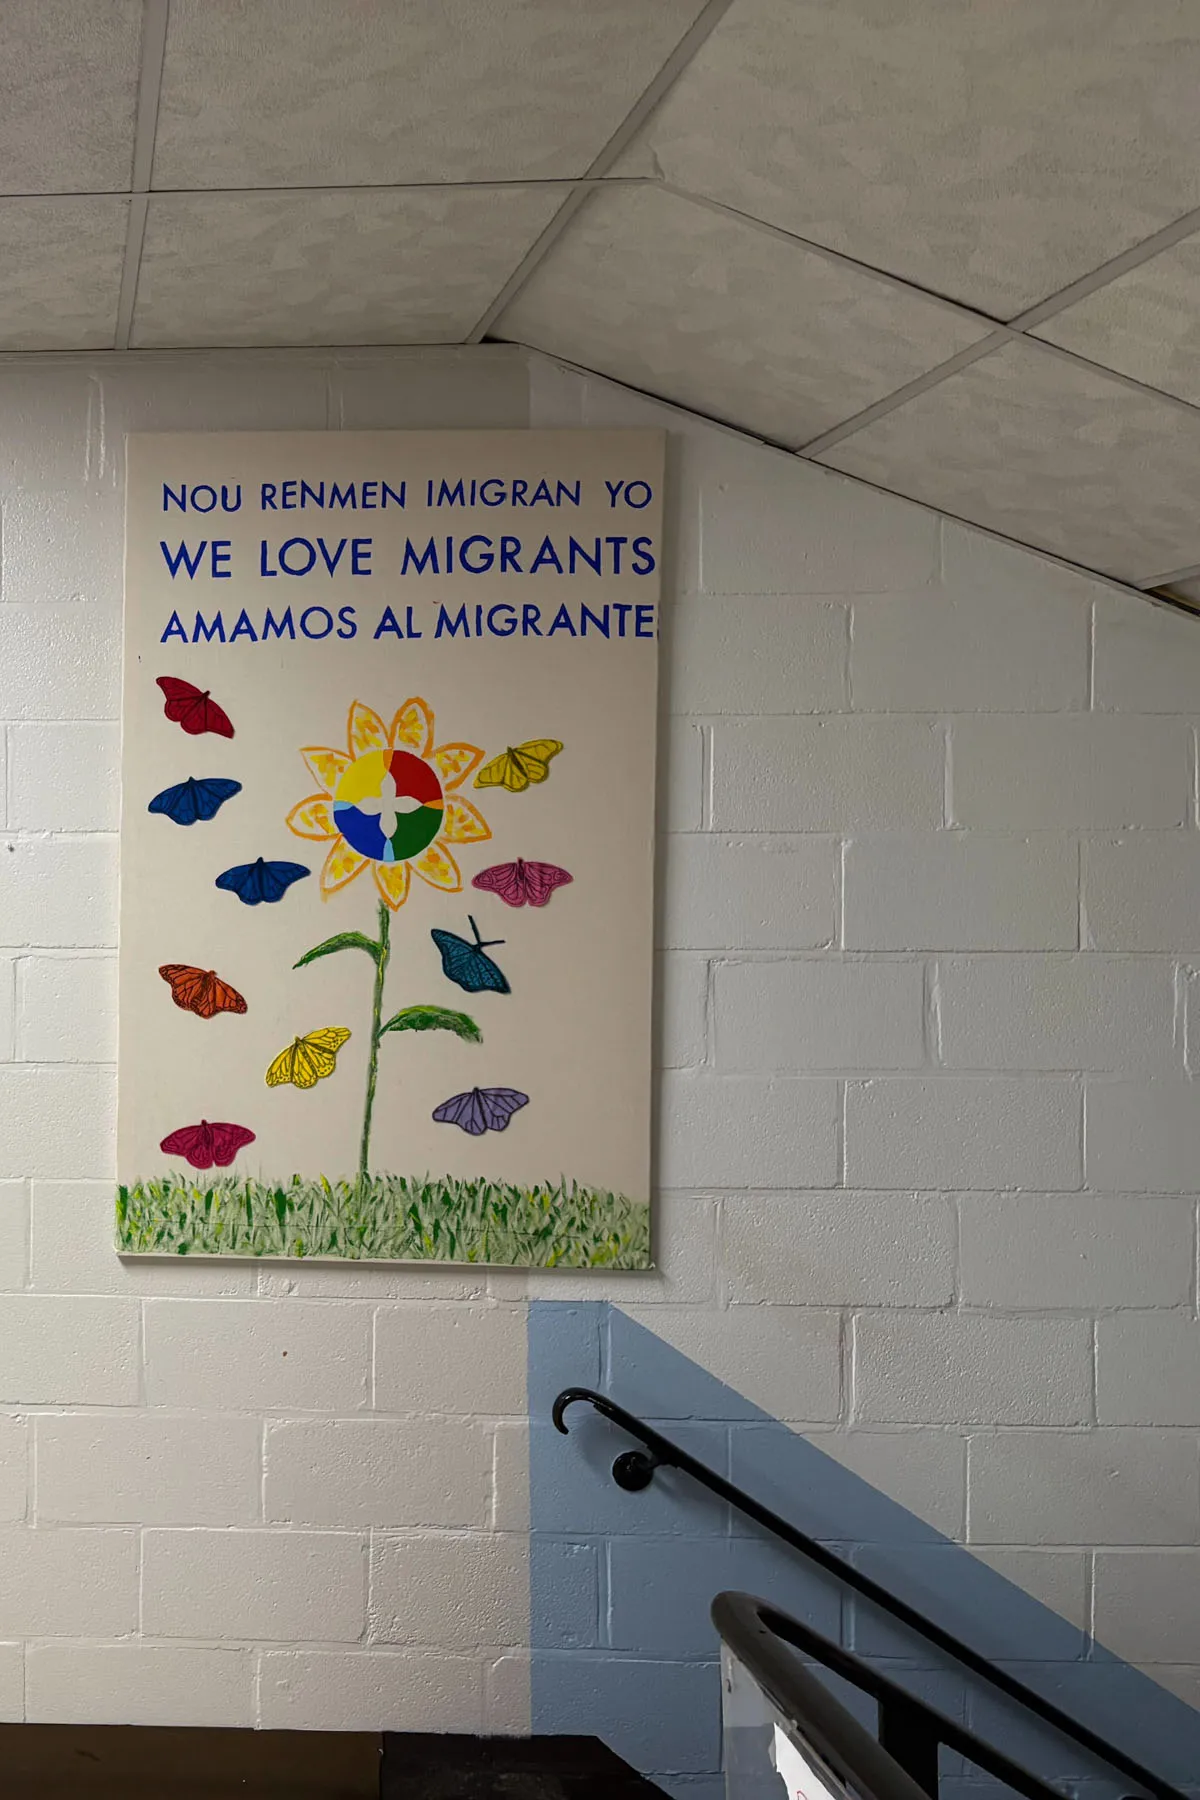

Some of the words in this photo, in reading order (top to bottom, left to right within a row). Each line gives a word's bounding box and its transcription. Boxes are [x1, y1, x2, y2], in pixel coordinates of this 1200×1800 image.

[162, 482, 242, 513] NOU
[261, 480, 406, 510] RENMEN
[427, 479, 581, 507] IMIGRAN
[605, 481, 653, 508] YO
[160, 540, 232, 579] WE
[260, 537, 373, 577] LOVE
[401, 534, 656, 575] MIGRANTS
[160, 605, 358, 643] AMAMOS
[373, 605, 423, 639] AL
[434, 602, 656, 639] MIGRANTE
